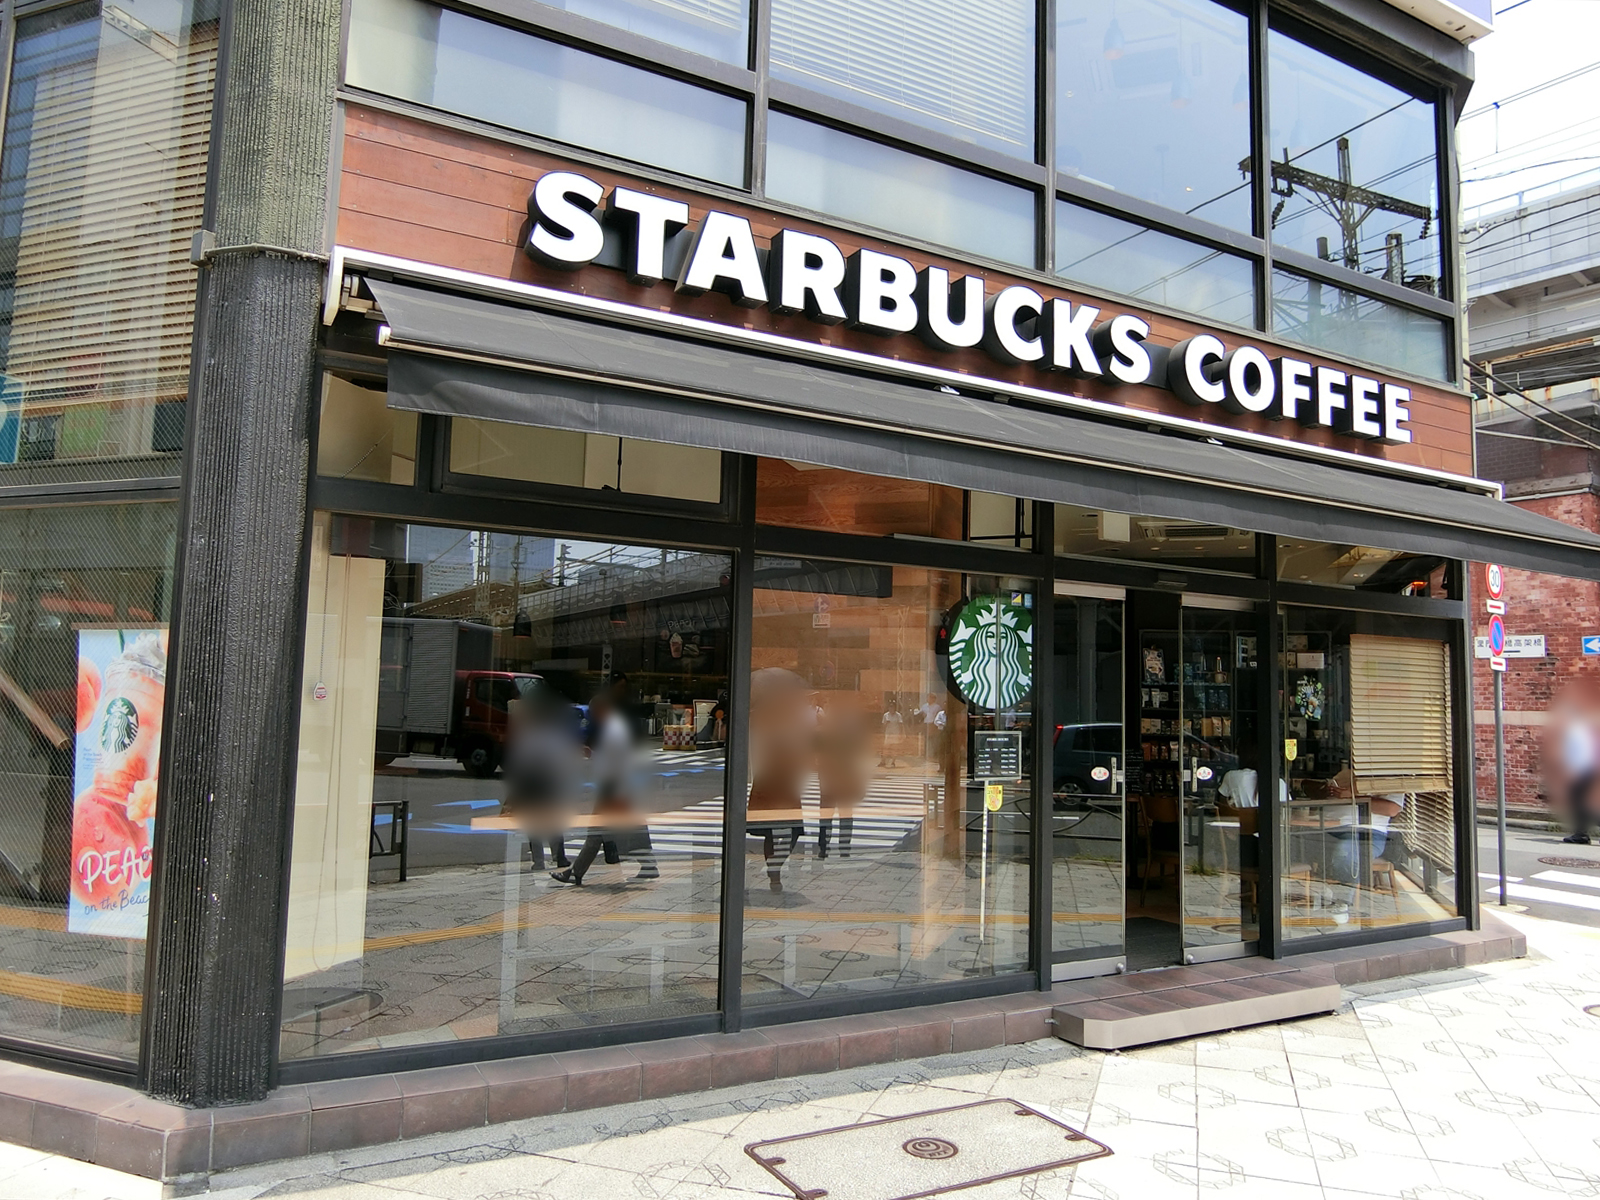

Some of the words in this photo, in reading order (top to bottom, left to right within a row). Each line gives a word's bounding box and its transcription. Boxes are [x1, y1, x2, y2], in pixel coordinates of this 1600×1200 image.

[529, 169, 1152, 384] STARBUCKS
[1184, 333, 1412, 443] COFFEE
[1490, 569, 1500, 588] 30
[84, 904, 98, 915] on
[99, 896, 118, 911] the
